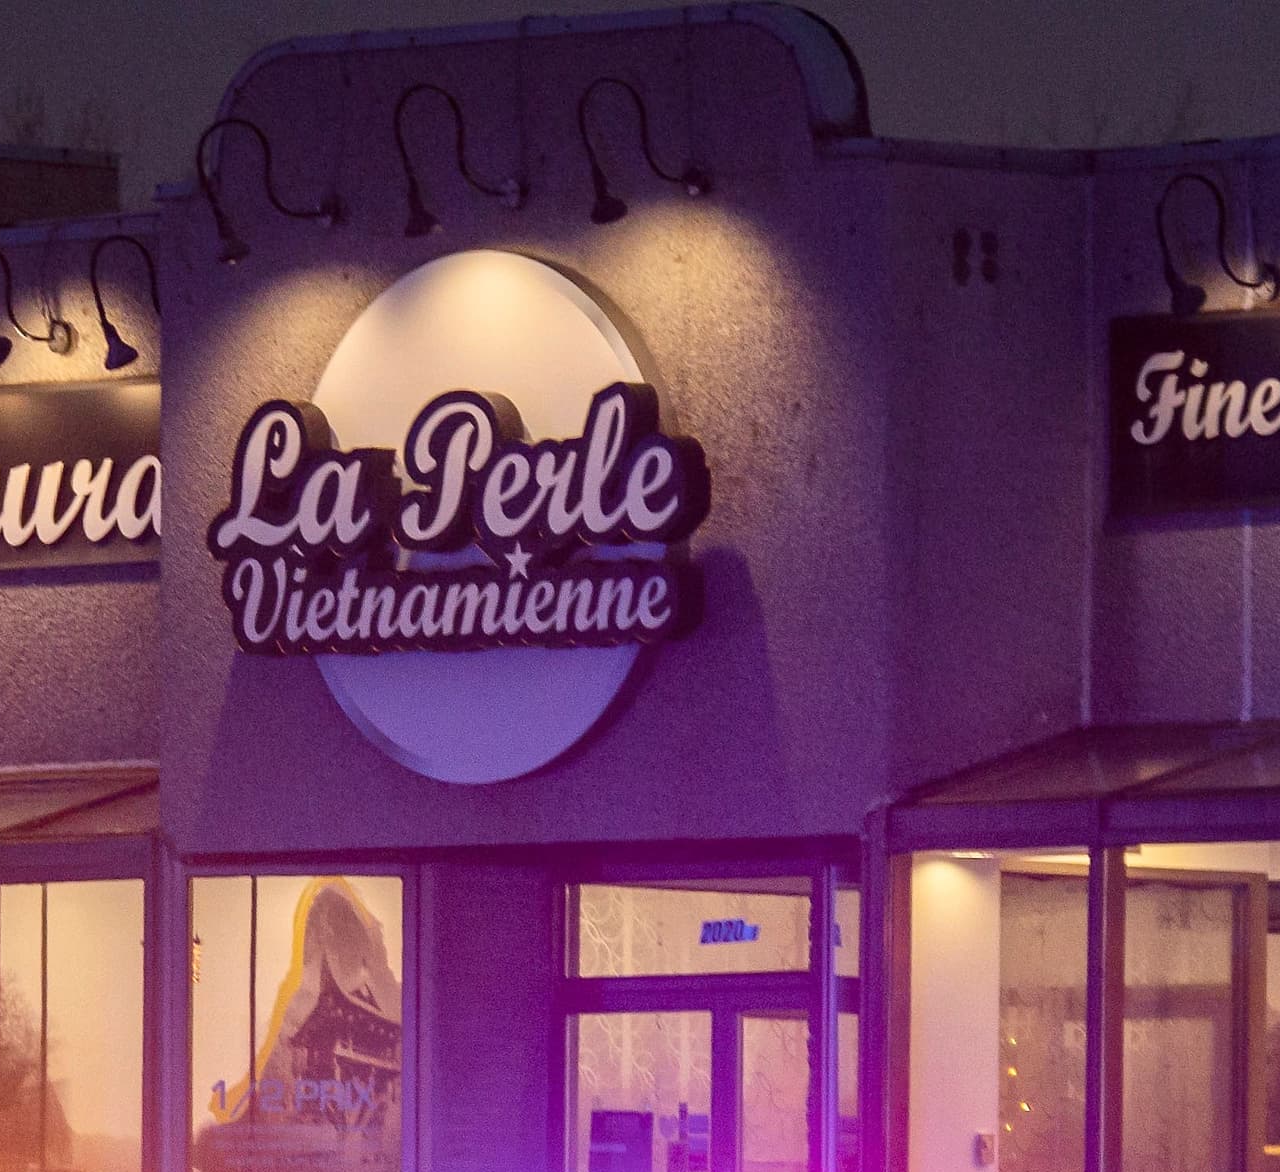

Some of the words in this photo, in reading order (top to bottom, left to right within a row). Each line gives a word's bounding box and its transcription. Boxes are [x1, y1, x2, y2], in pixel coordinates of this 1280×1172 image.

[217, 409, 370, 548] La
[401, 393, 679, 541] Perle
[231, 545, 672, 643] Vietnamienne
